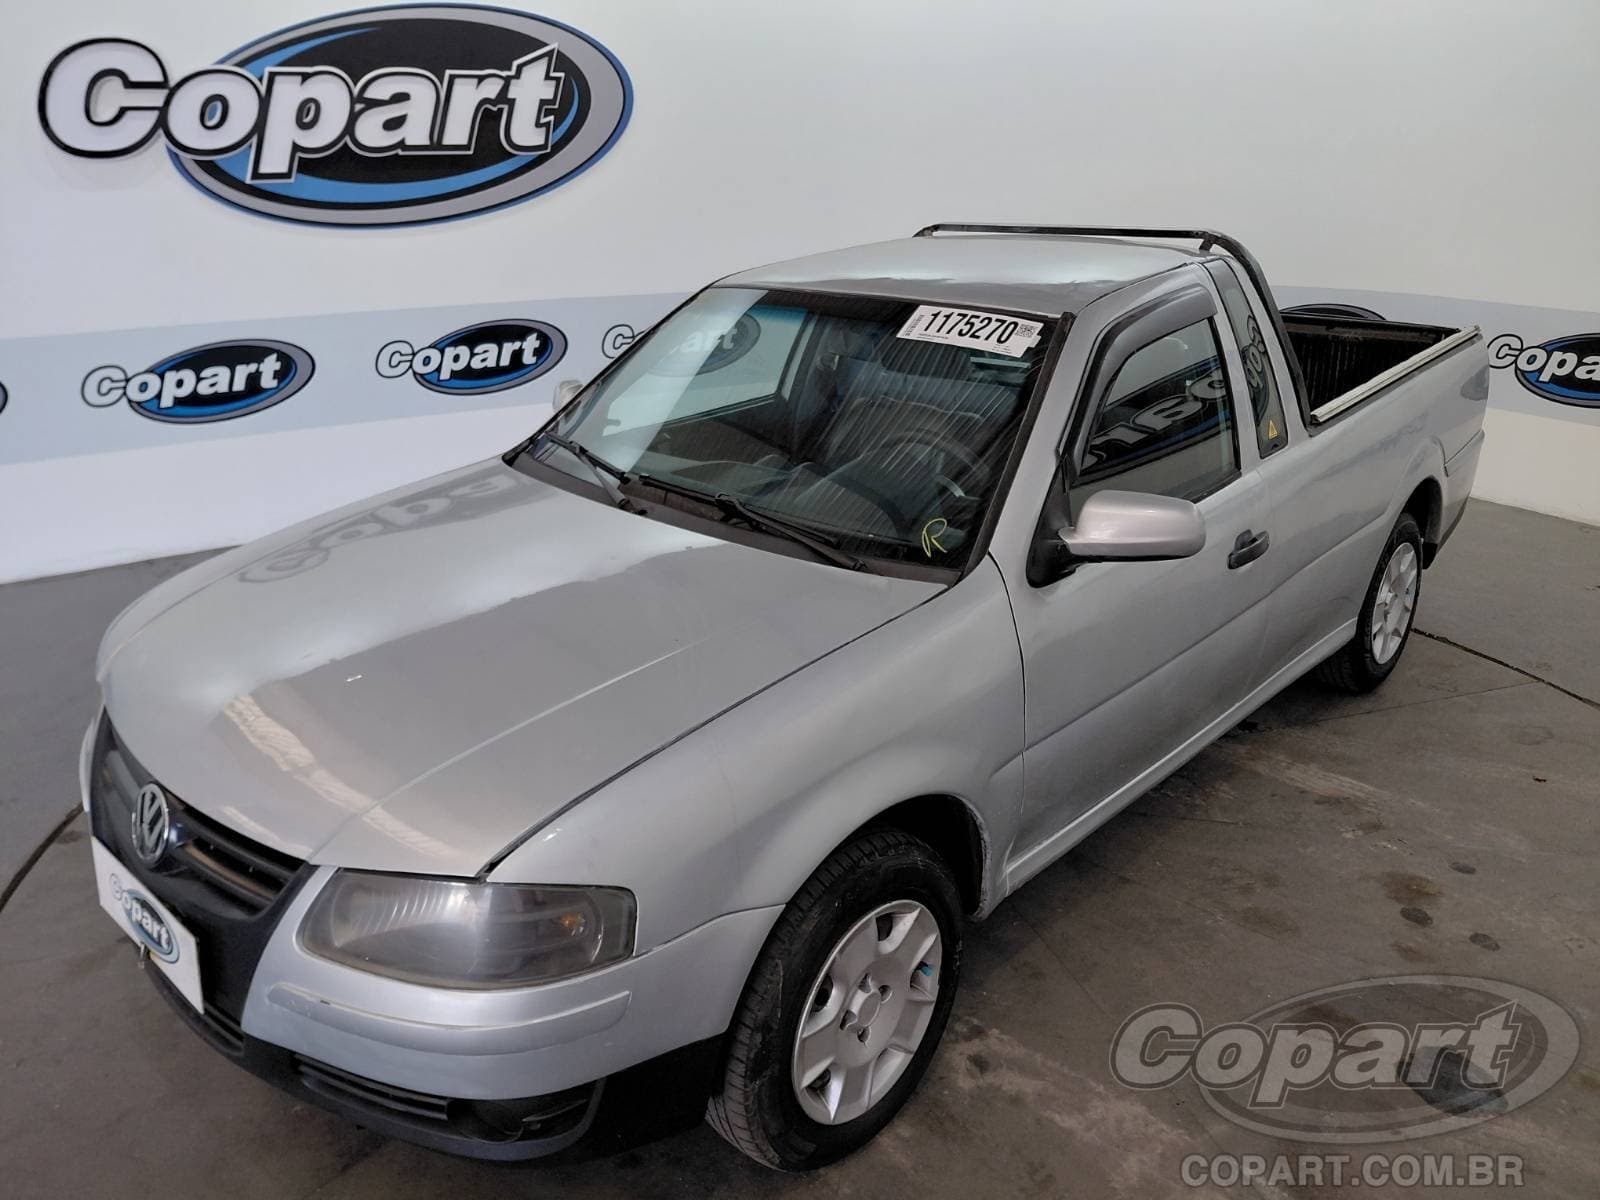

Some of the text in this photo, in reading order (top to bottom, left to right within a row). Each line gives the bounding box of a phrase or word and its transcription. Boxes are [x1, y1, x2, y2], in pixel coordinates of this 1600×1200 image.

[39, 38, 564, 183] Copart
[924, 310, 1019, 344] 1175270
[81, 352, 281, 408] Copart
[375, 332, 540, 380] Copart
[922, 518, 948, 558] R
[109, 872, 170, 951] Copart
